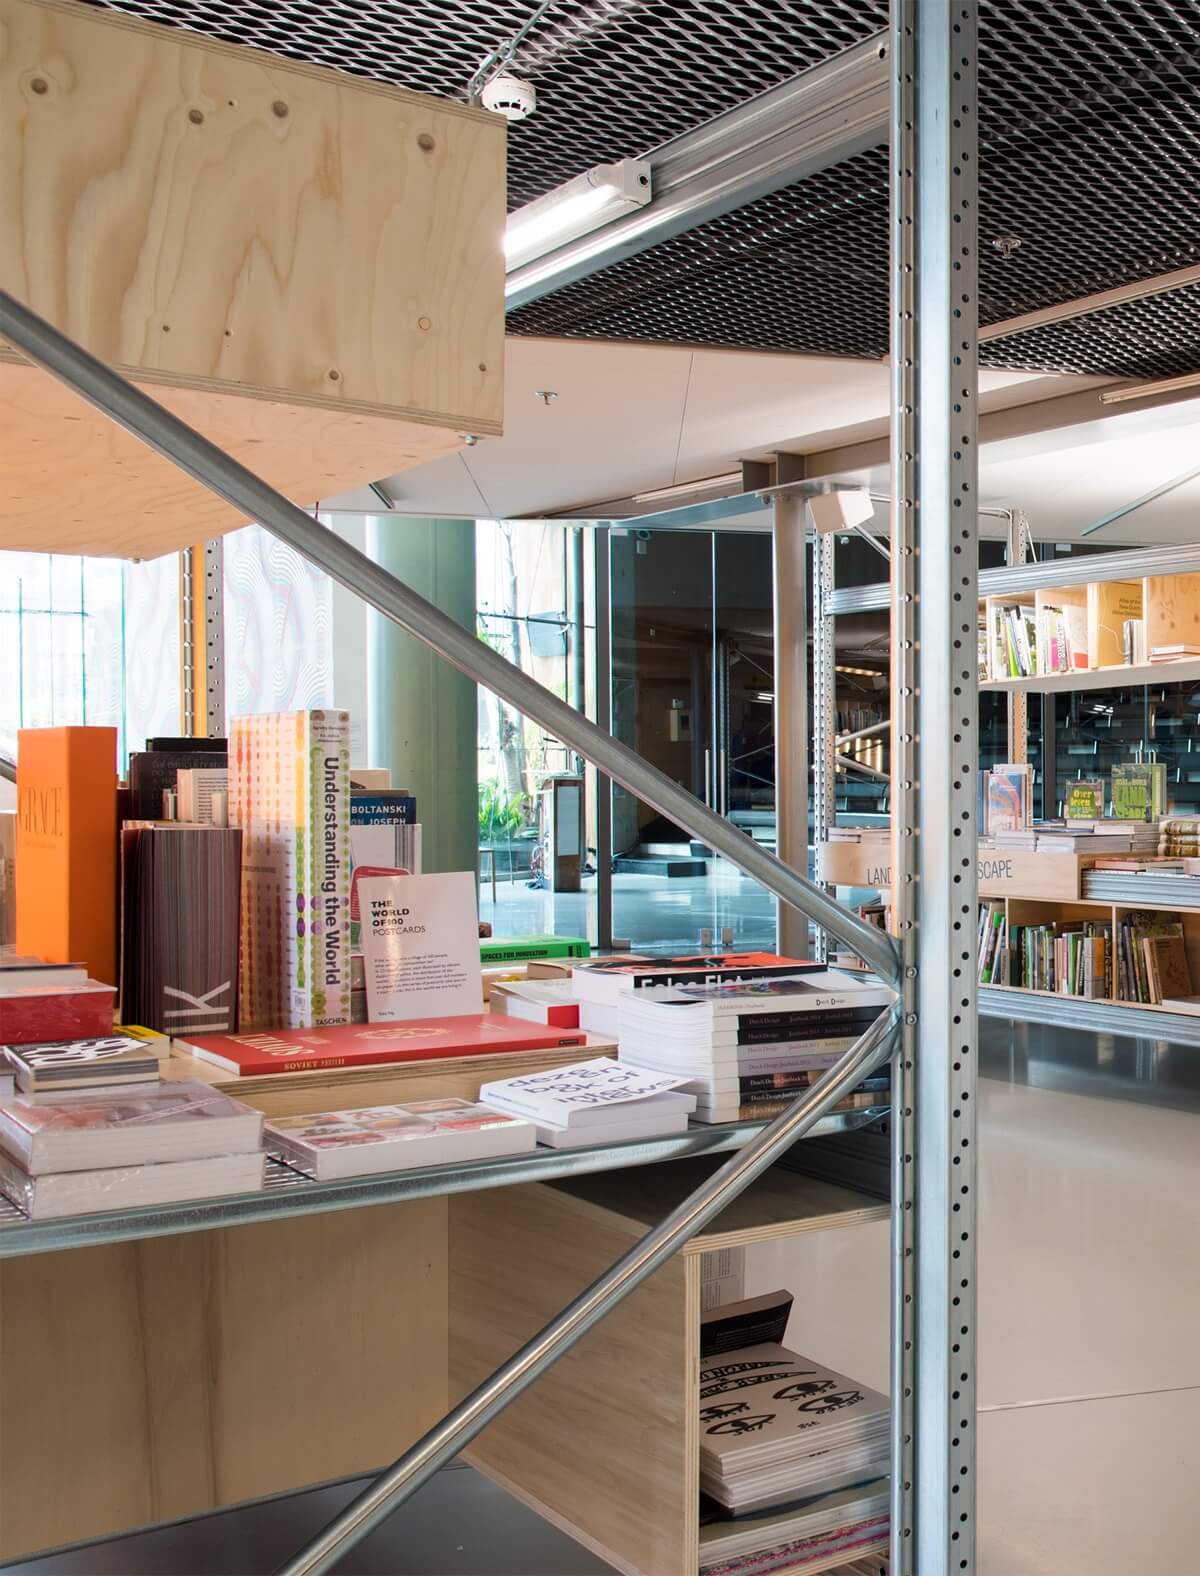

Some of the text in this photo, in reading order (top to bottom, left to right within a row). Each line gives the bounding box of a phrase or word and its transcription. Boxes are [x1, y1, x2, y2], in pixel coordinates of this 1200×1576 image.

[351, 805, 406, 814] BOLTANSKI
[321, 757, 340, 892] Understanding
[371, 900, 393, 908] THE
[325, 897, 340, 926] the
[371, 908, 410, 917] WORLD
[372, 919, 386, 927] OF
[373, 925, 426, 936] POSTCARDS
[325, 930, 341, 985] World
[315, 1017, 347, 1027] TASCHEN
[284, 1060, 317, 1070] SOVIET
[608, 1070, 641, 1084] of
